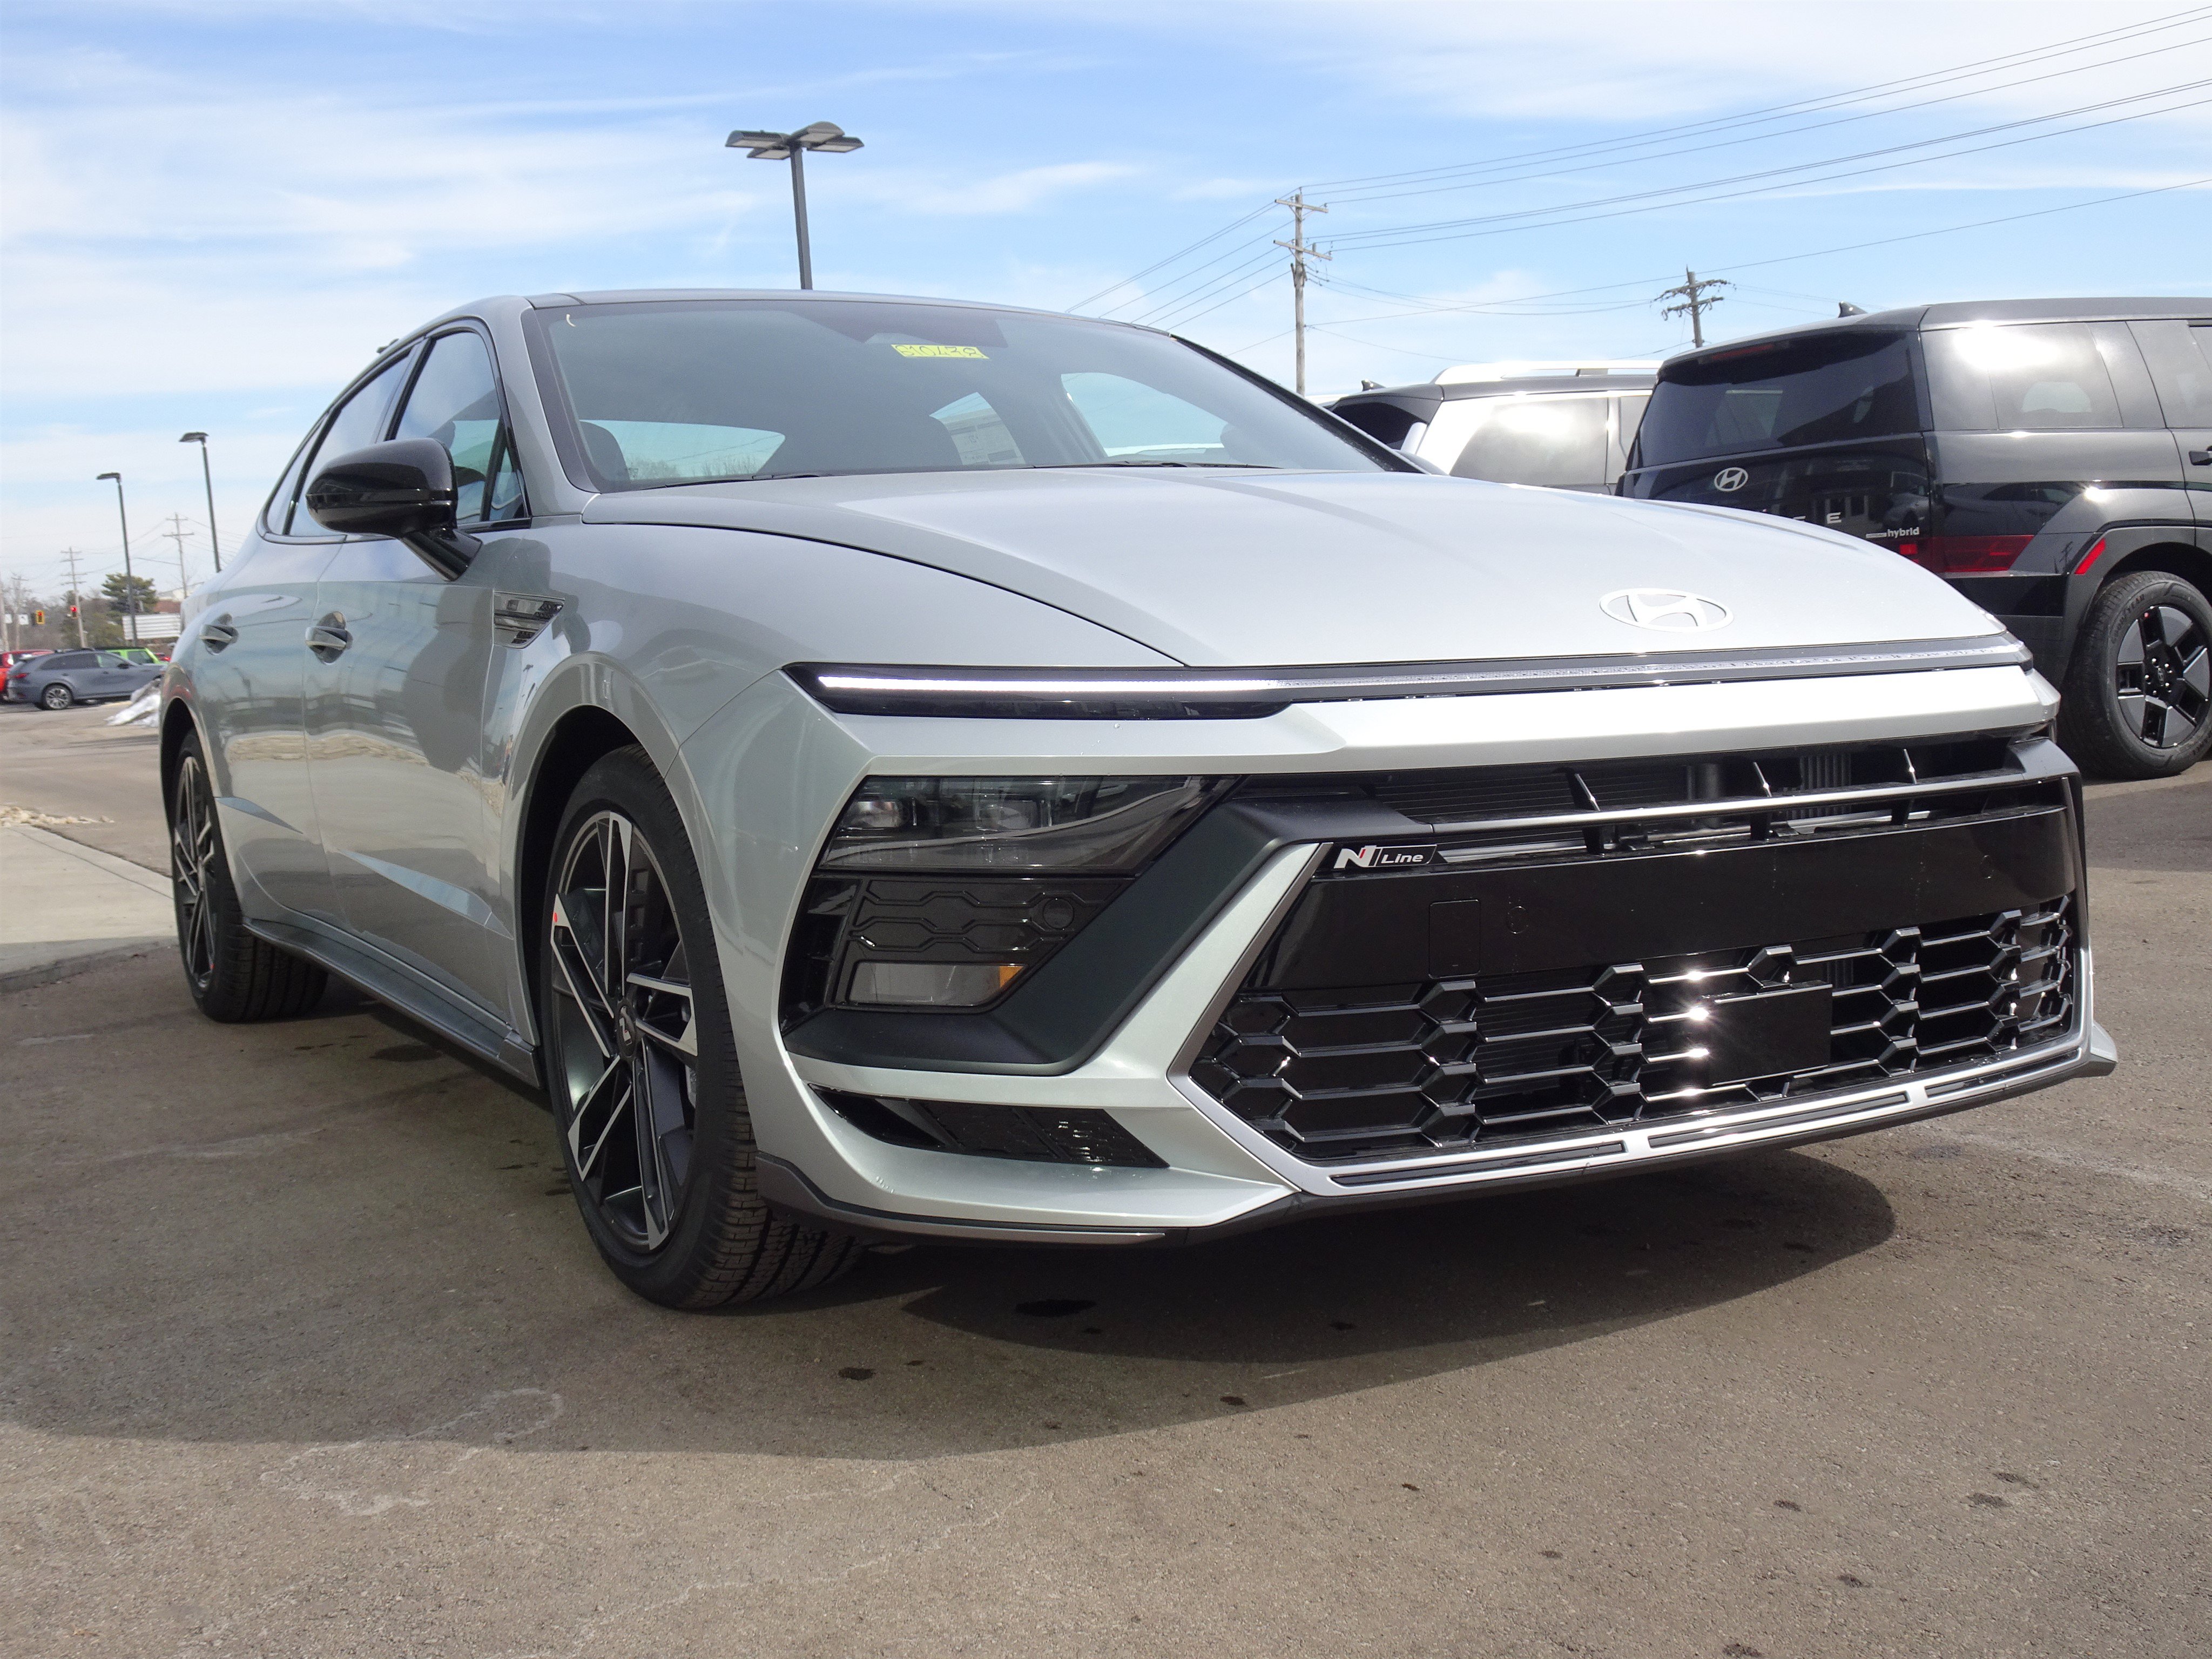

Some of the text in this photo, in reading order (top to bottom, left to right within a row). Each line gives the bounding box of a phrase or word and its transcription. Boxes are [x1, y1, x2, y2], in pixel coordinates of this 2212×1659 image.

[1887, 527, 1920, 538] hybrid
[1333, 845, 1424, 869] N Line
